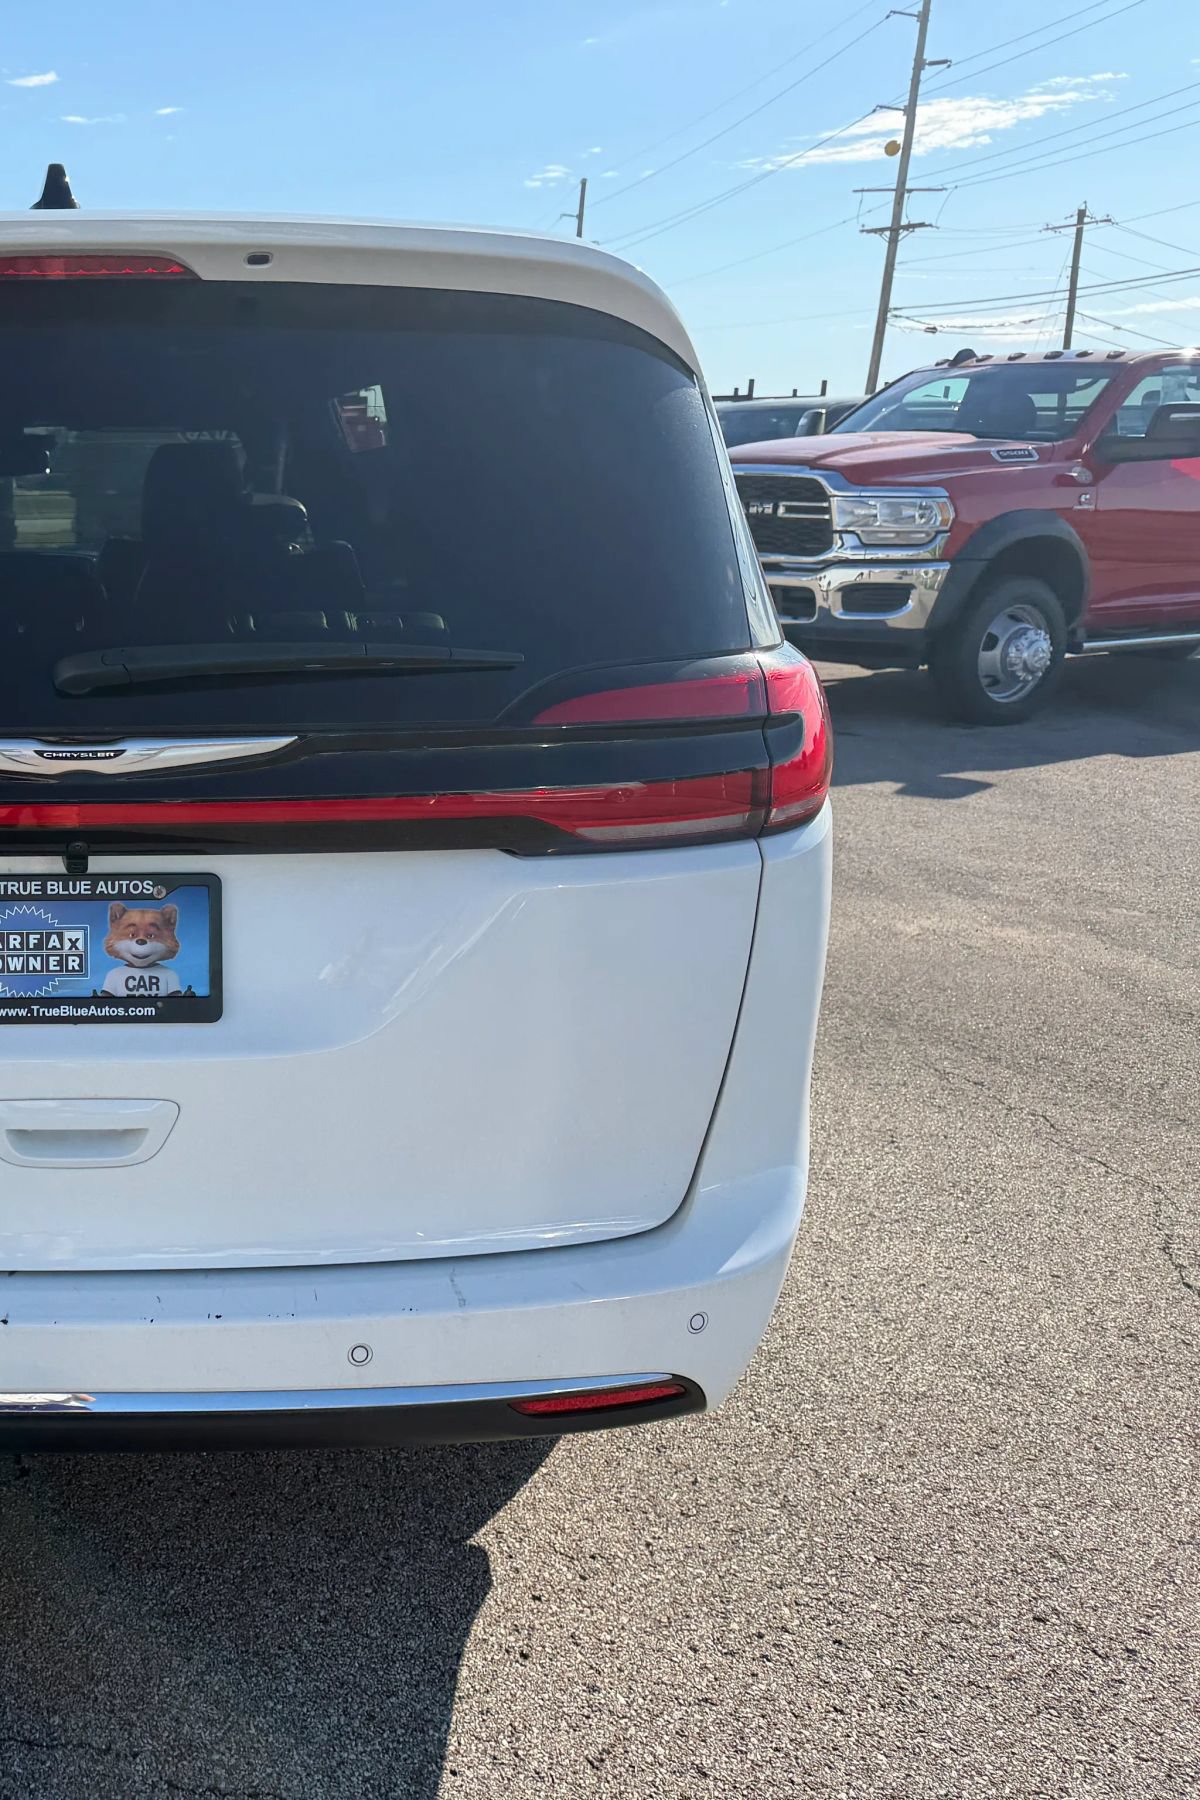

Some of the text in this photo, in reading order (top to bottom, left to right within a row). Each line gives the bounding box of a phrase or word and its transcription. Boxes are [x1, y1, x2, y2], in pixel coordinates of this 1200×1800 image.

[46, 881, 91, 895] BLUE
[97, 881, 154, 894] AUTOS
[125, 975, 160, 992] CAR
